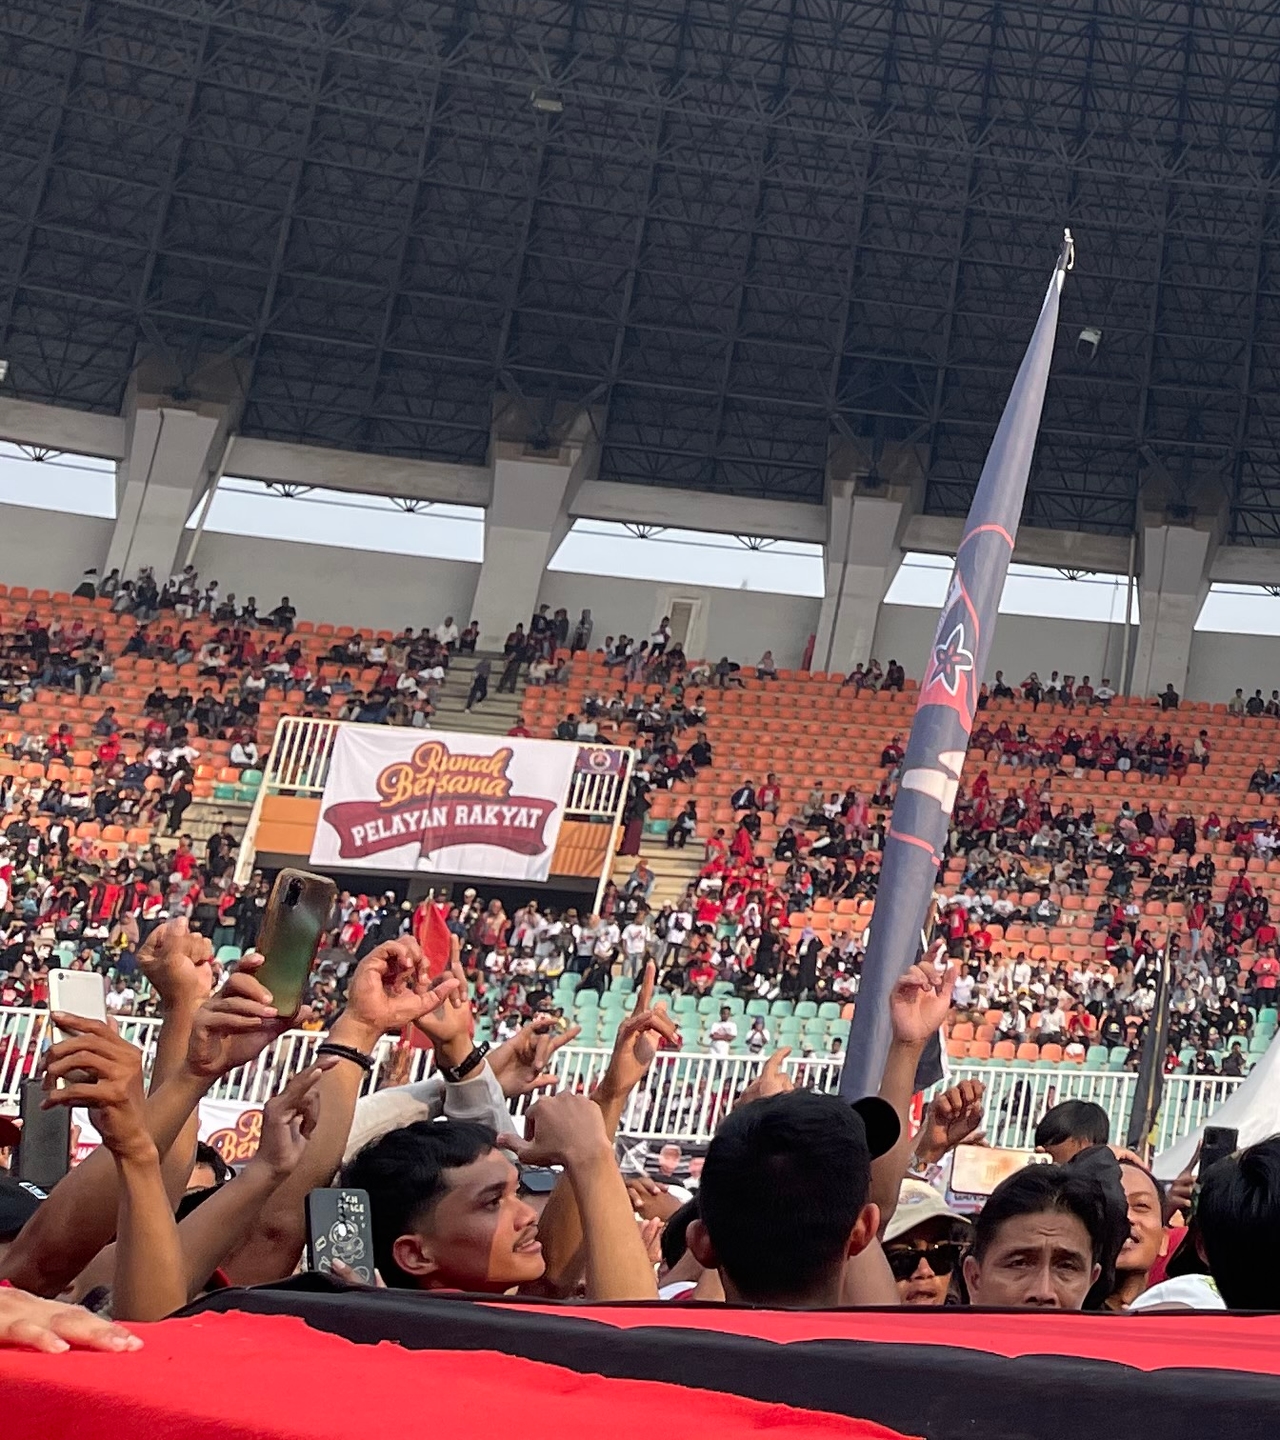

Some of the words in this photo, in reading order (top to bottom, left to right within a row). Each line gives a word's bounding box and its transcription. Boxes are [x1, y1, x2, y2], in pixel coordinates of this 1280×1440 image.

[414, 742, 508, 777] Rumah
[379, 763, 507, 807] Bersama
[351, 808, 448, 847] PELAYAN
[455, 805, 543, 829] RAKYAT
